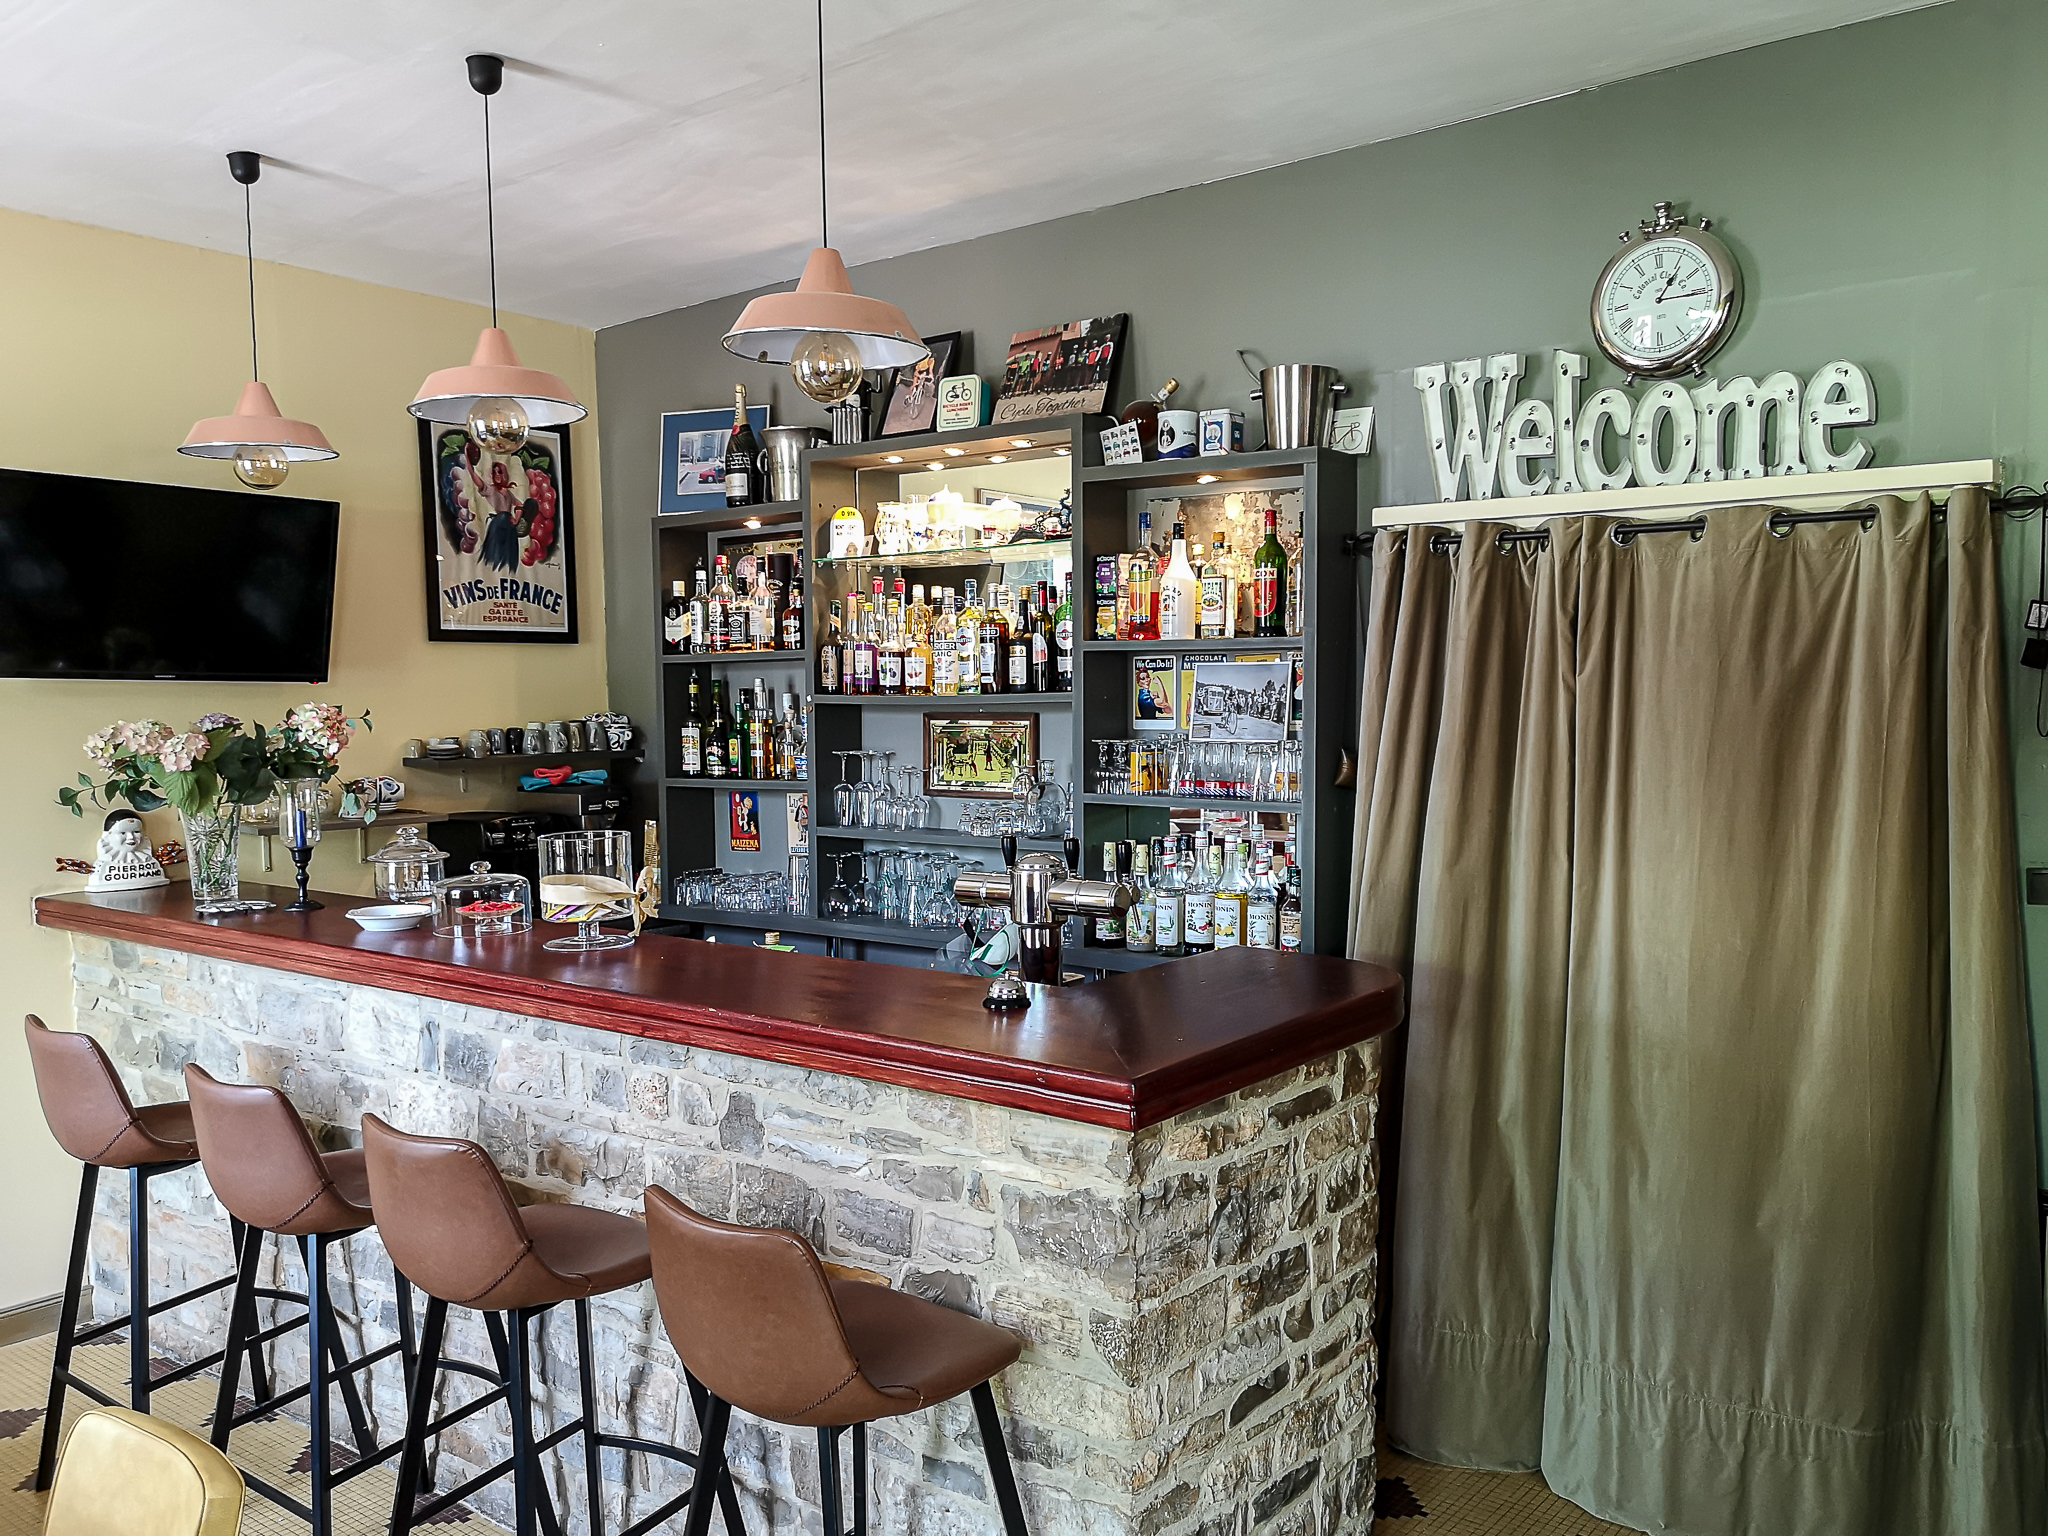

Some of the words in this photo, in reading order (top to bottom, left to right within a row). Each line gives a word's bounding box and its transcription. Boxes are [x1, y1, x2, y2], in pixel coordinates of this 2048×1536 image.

[1632, 272, 1658, 300] Colonial
[1000, 403, 1034, 421] Cycle
[1034, 397, 1086, 415] Together
[1413, 348, 1878, 503] Welcome
[443, 579, 487, 610] VINS
[486, 586, 499, 600] DE
[499, 578, 564, 614] FRANCE
[1136, 660, 1145, 668] We
[1145, 660, 1156, 668] Can
[1165, 659, 1173, 668] It!
[731, 839, 759, 848] MAIZENA
[104, 869, 161, 881] GOURMAND
[109, 862, 156, 873] PIERROT
